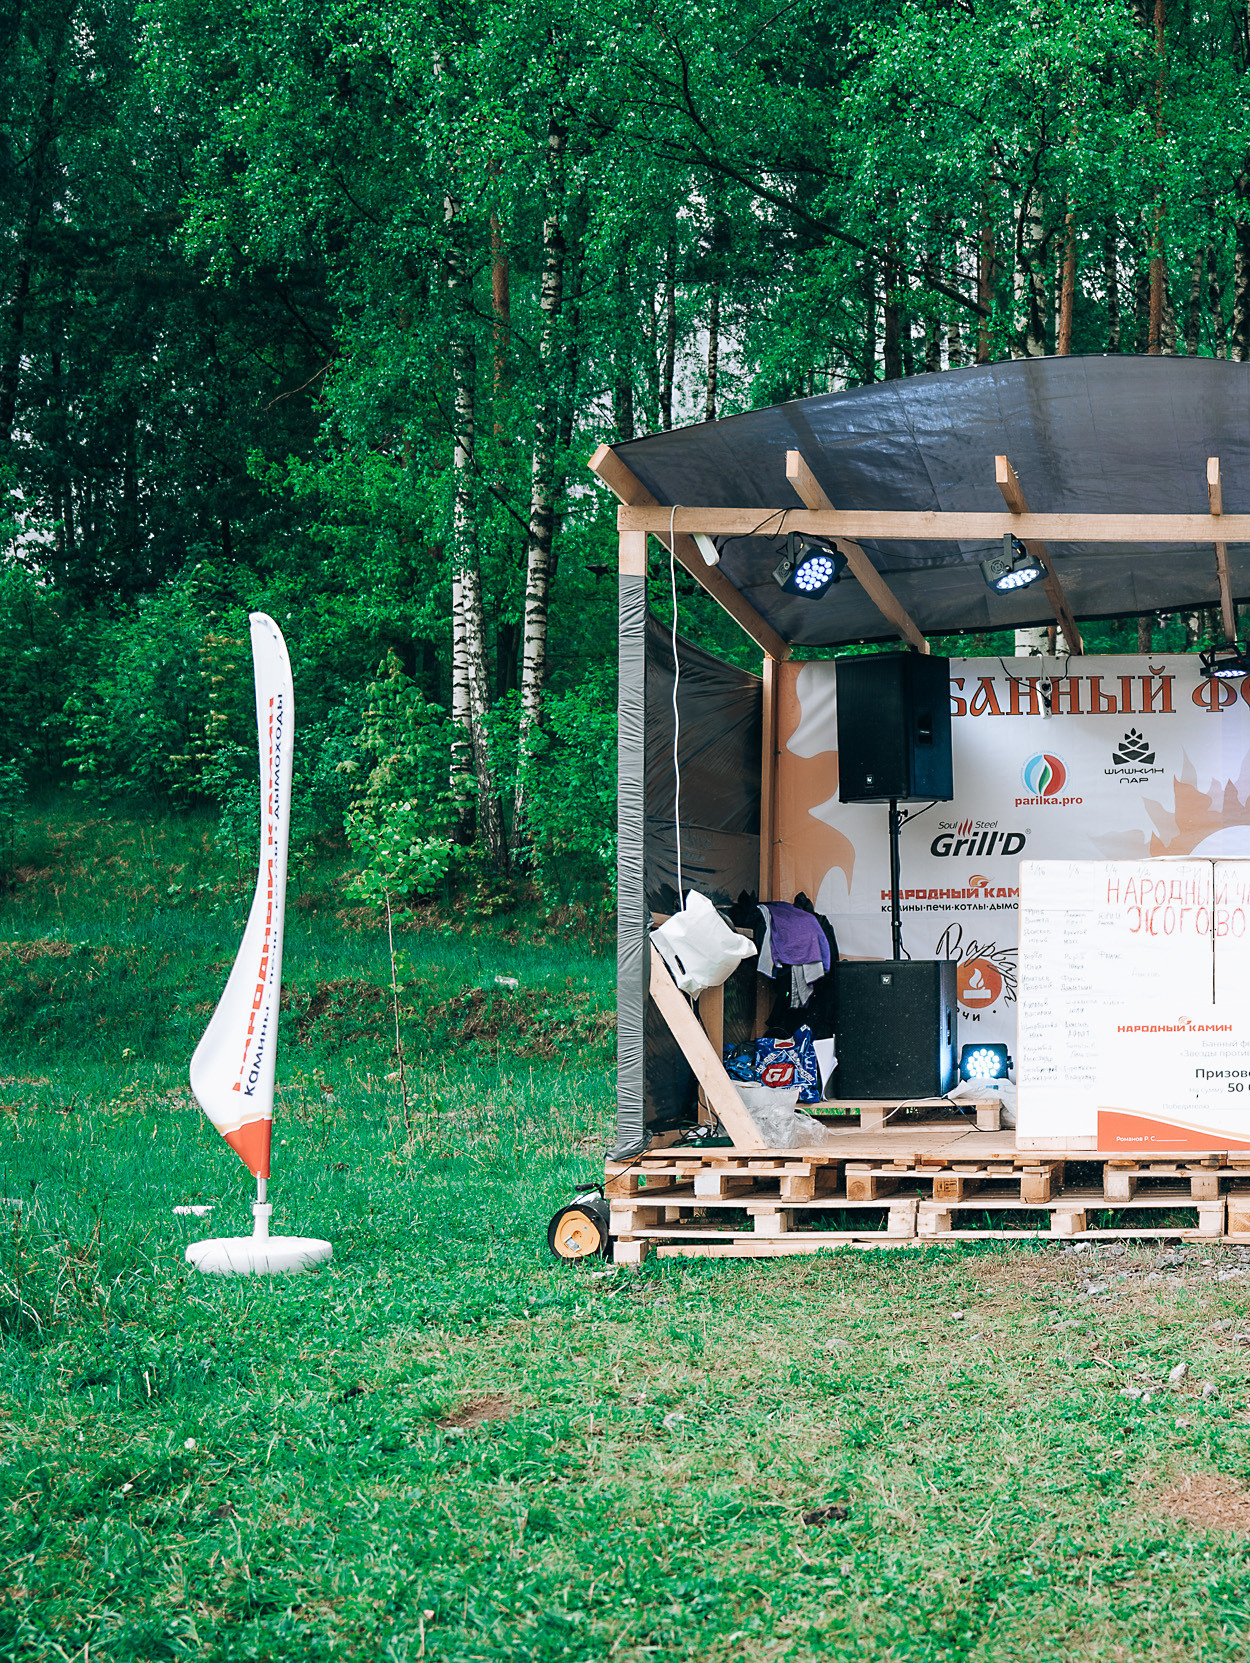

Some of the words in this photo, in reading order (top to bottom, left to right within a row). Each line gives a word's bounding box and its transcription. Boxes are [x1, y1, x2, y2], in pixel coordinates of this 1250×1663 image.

[938, 821, 958, 830] Soul
[975, 820, 998, 829] Steel
[1117, 1025, 1186, 1033] НАРОДНЫЙ
[1189, 1024, 1233, 1032] КАМИН
[1201, 1039, 1238, 1048] Банный
[1227, 1082, 1245, 1093] 50
